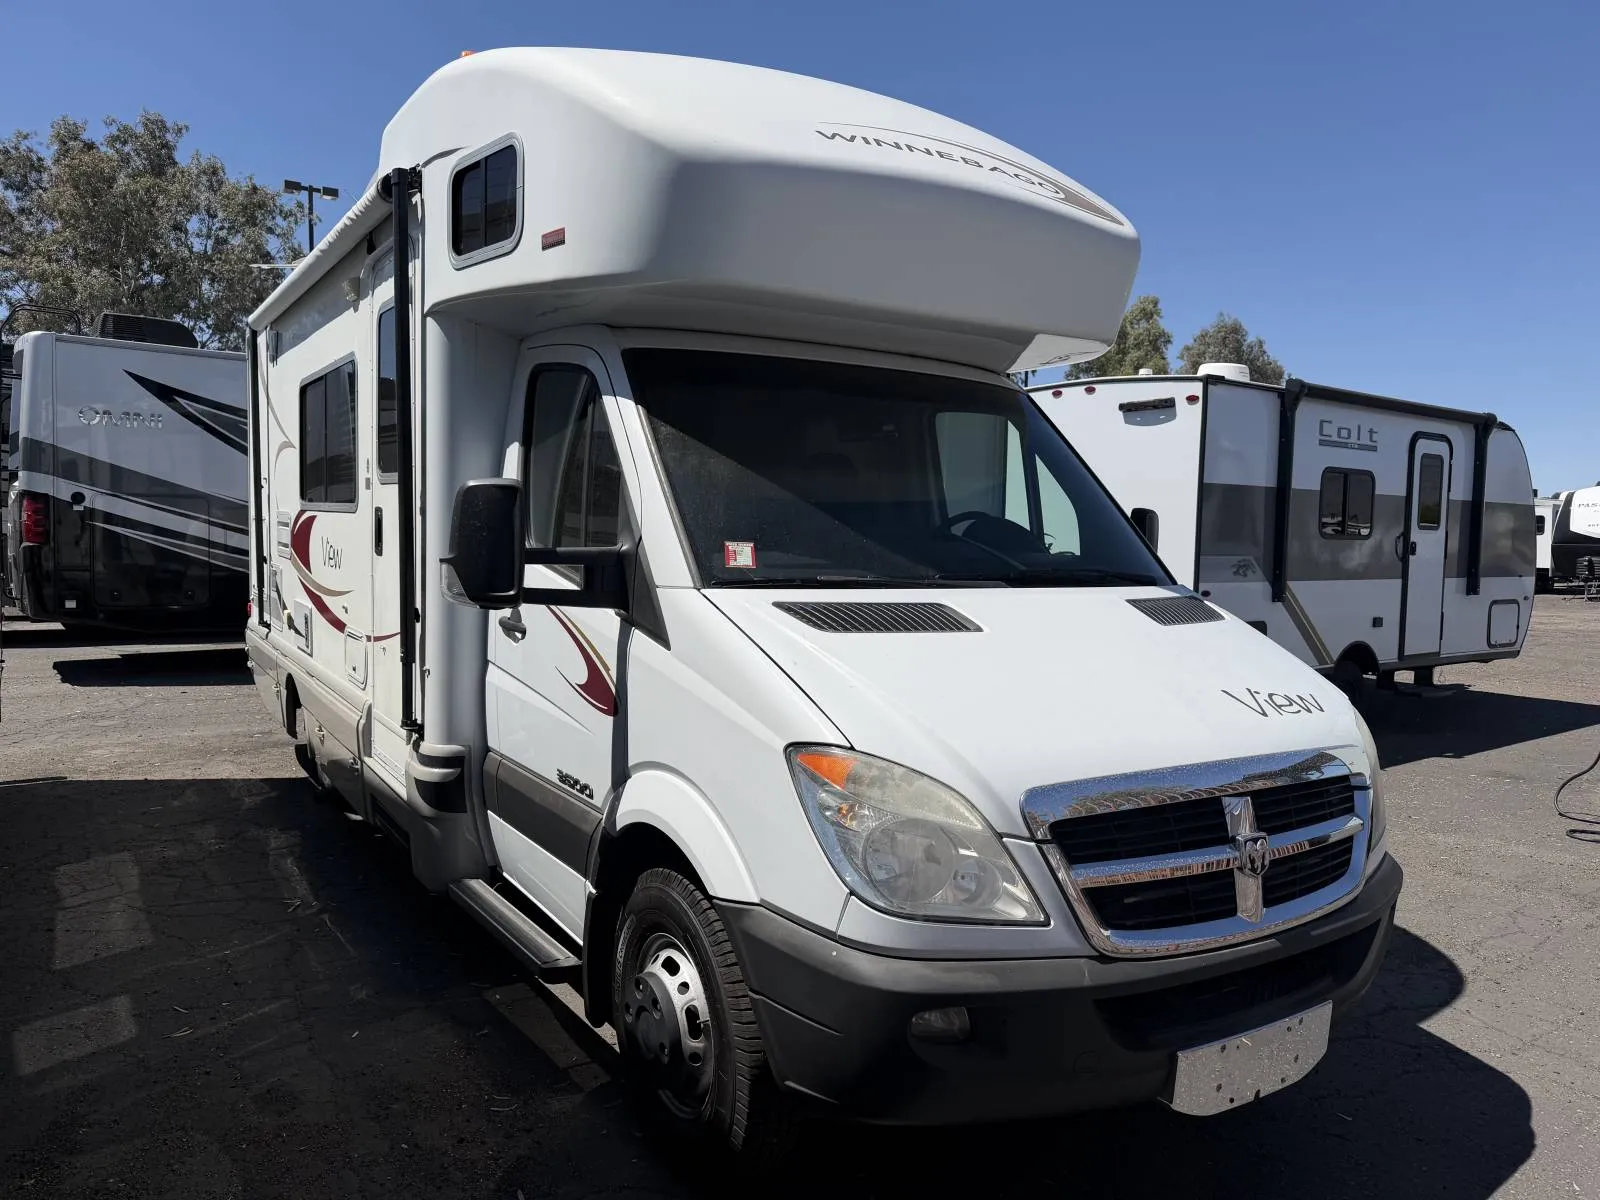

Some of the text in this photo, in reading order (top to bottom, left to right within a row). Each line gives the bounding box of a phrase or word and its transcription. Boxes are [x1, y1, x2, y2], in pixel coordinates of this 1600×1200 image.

[815, 129, 1061, 195] WINNEBAGO
[1318, 419, 1379, 443] Colt
[321, 535, 343, 571] View
[1220, 687, 1325, 718] View
